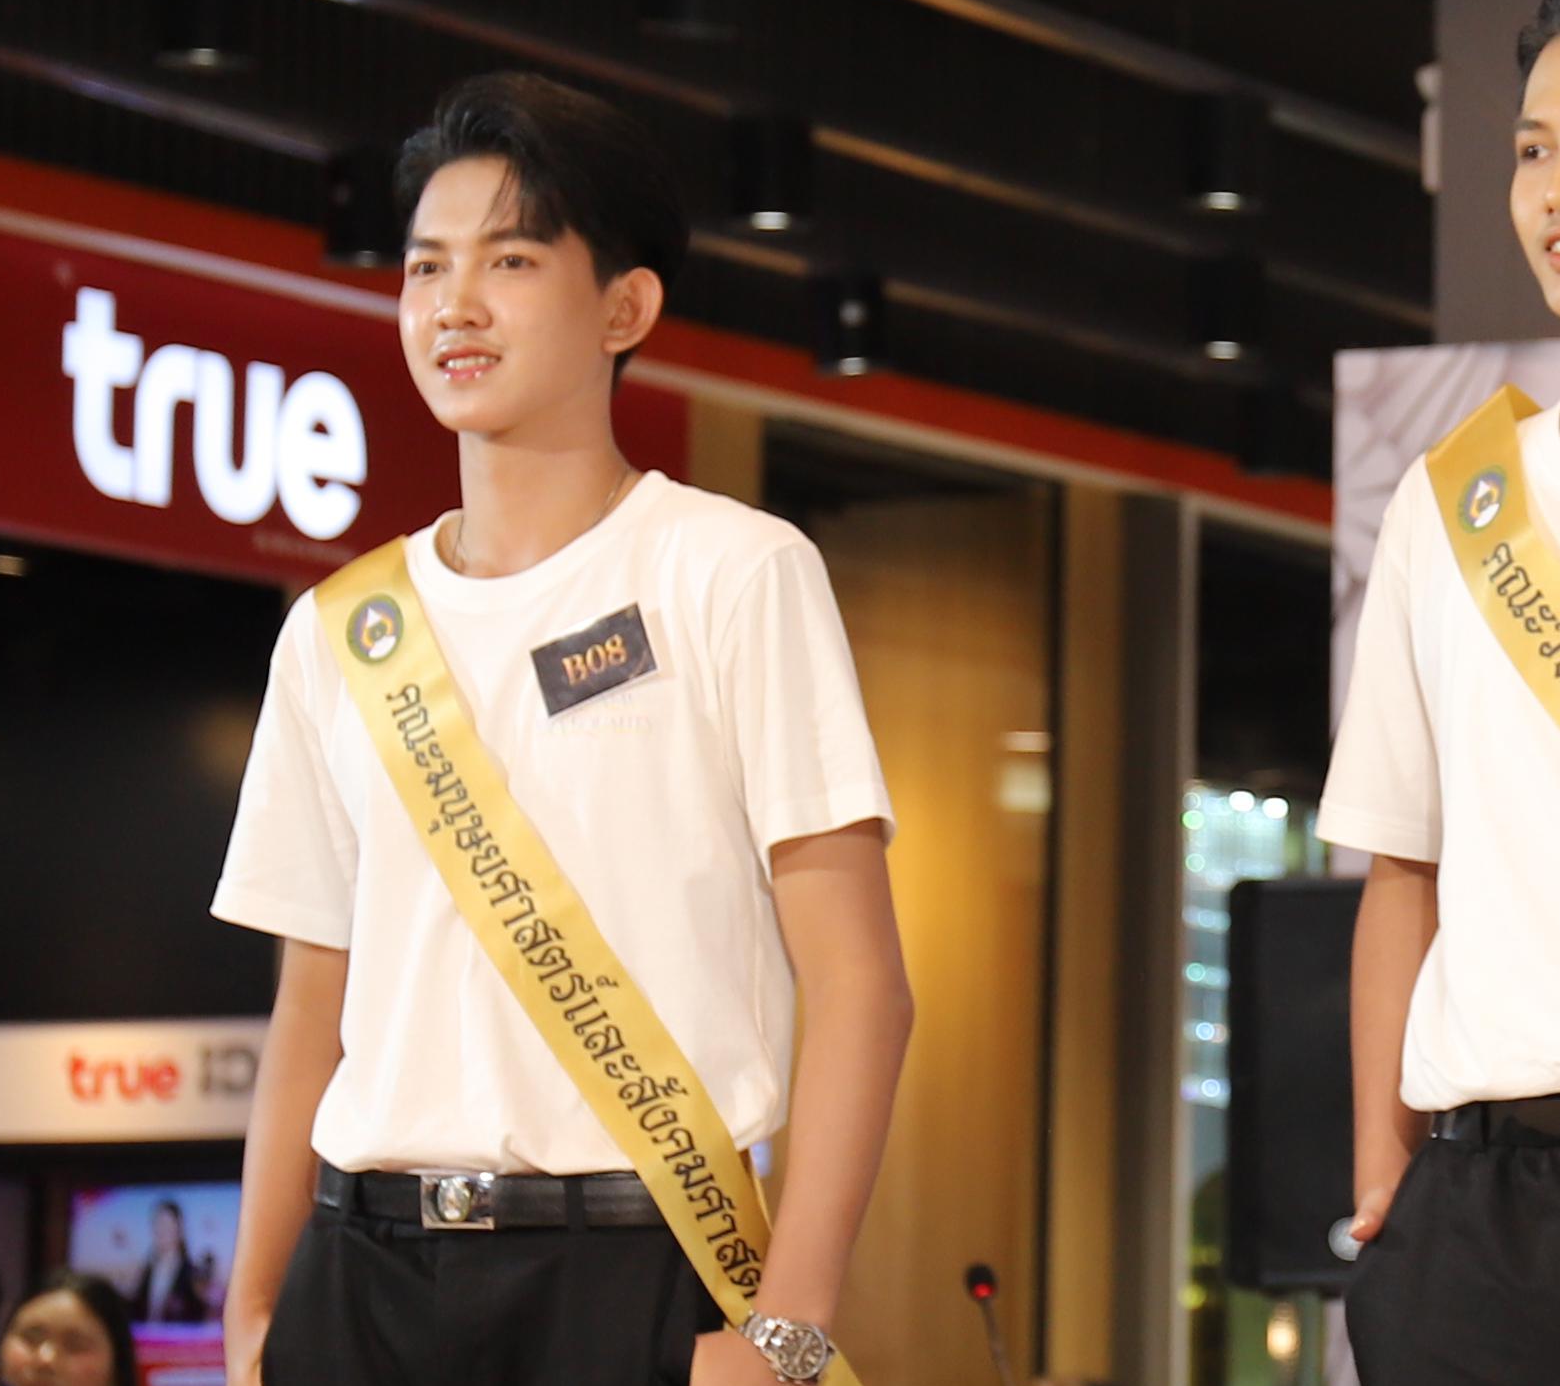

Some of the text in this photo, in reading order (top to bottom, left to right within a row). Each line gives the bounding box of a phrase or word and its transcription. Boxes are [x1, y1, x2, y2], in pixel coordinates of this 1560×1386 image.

[62, 286, 368, 541] true
[561, 633, 628, 687] B08
[69, 1048, 181, 1101] true
